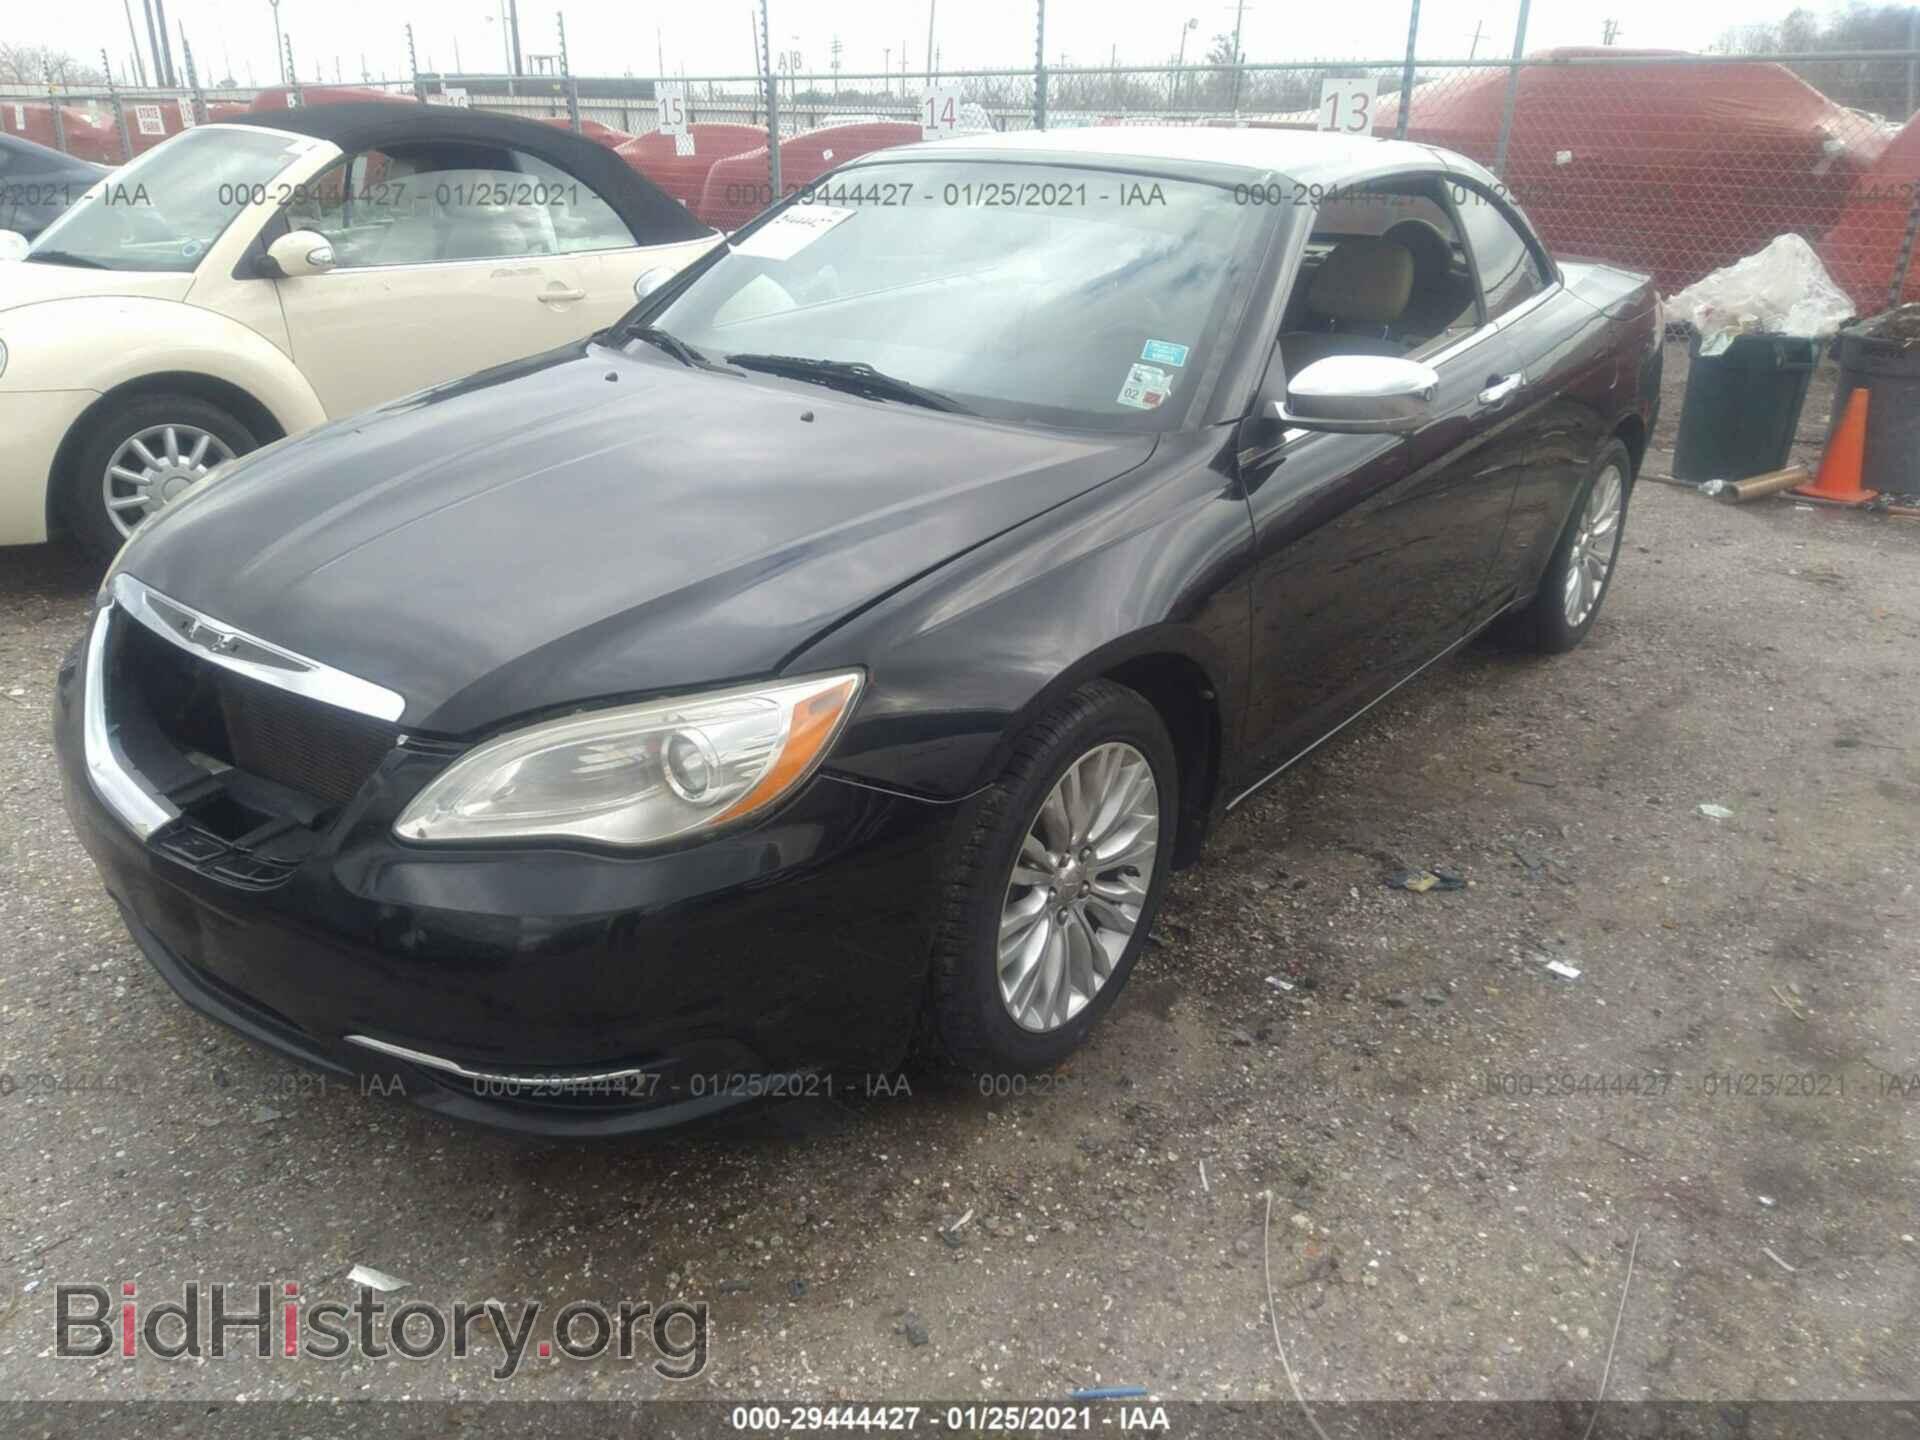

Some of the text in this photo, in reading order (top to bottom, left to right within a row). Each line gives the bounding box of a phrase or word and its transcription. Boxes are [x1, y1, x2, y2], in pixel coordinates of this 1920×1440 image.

[659, 98, 685, 126] 15
[925, 96, 957, 131] 14
[1322, 91, 1370, 132] 13
[1124, 387, 1139, 400] 02
